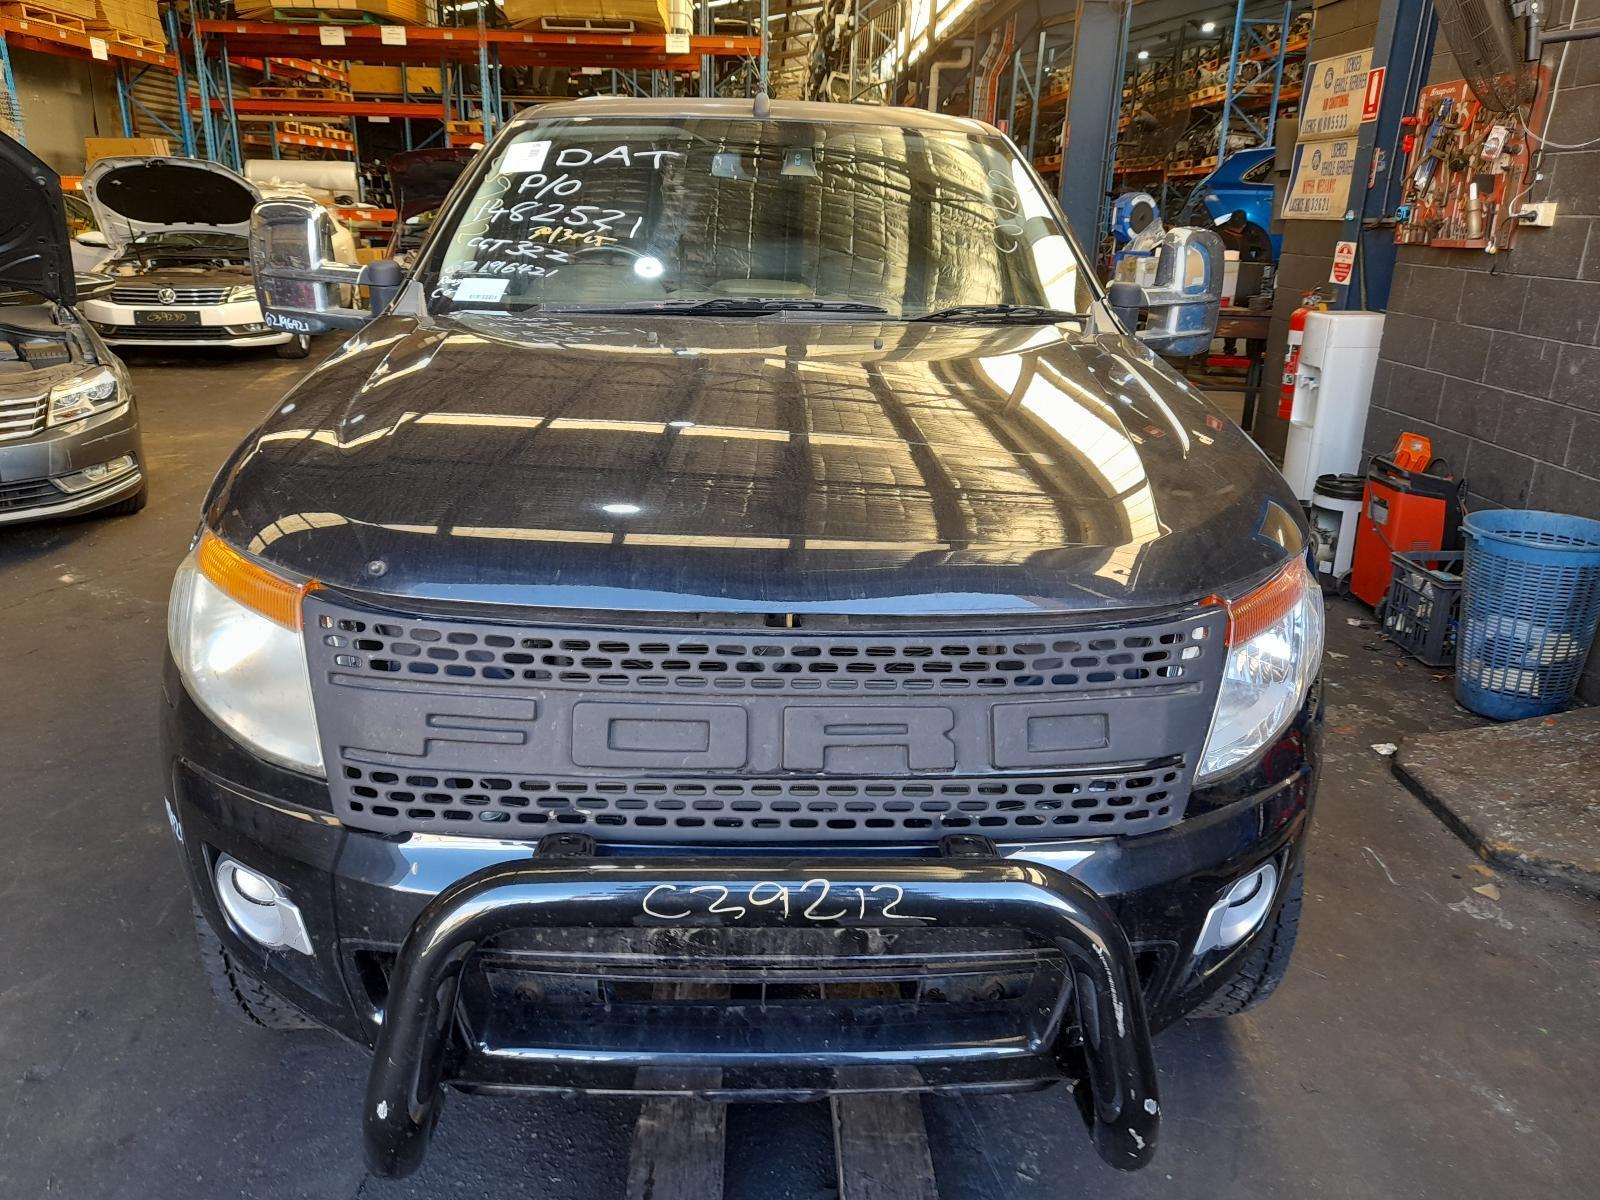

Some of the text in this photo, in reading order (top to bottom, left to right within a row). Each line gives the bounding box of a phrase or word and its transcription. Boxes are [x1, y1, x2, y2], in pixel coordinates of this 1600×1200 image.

[555, 145, 681, 170] DAT
[517, 173, 582, 199] P/O
[328, 676, 1196, 773] FORD
[642, 878, 938, 920] C39212
